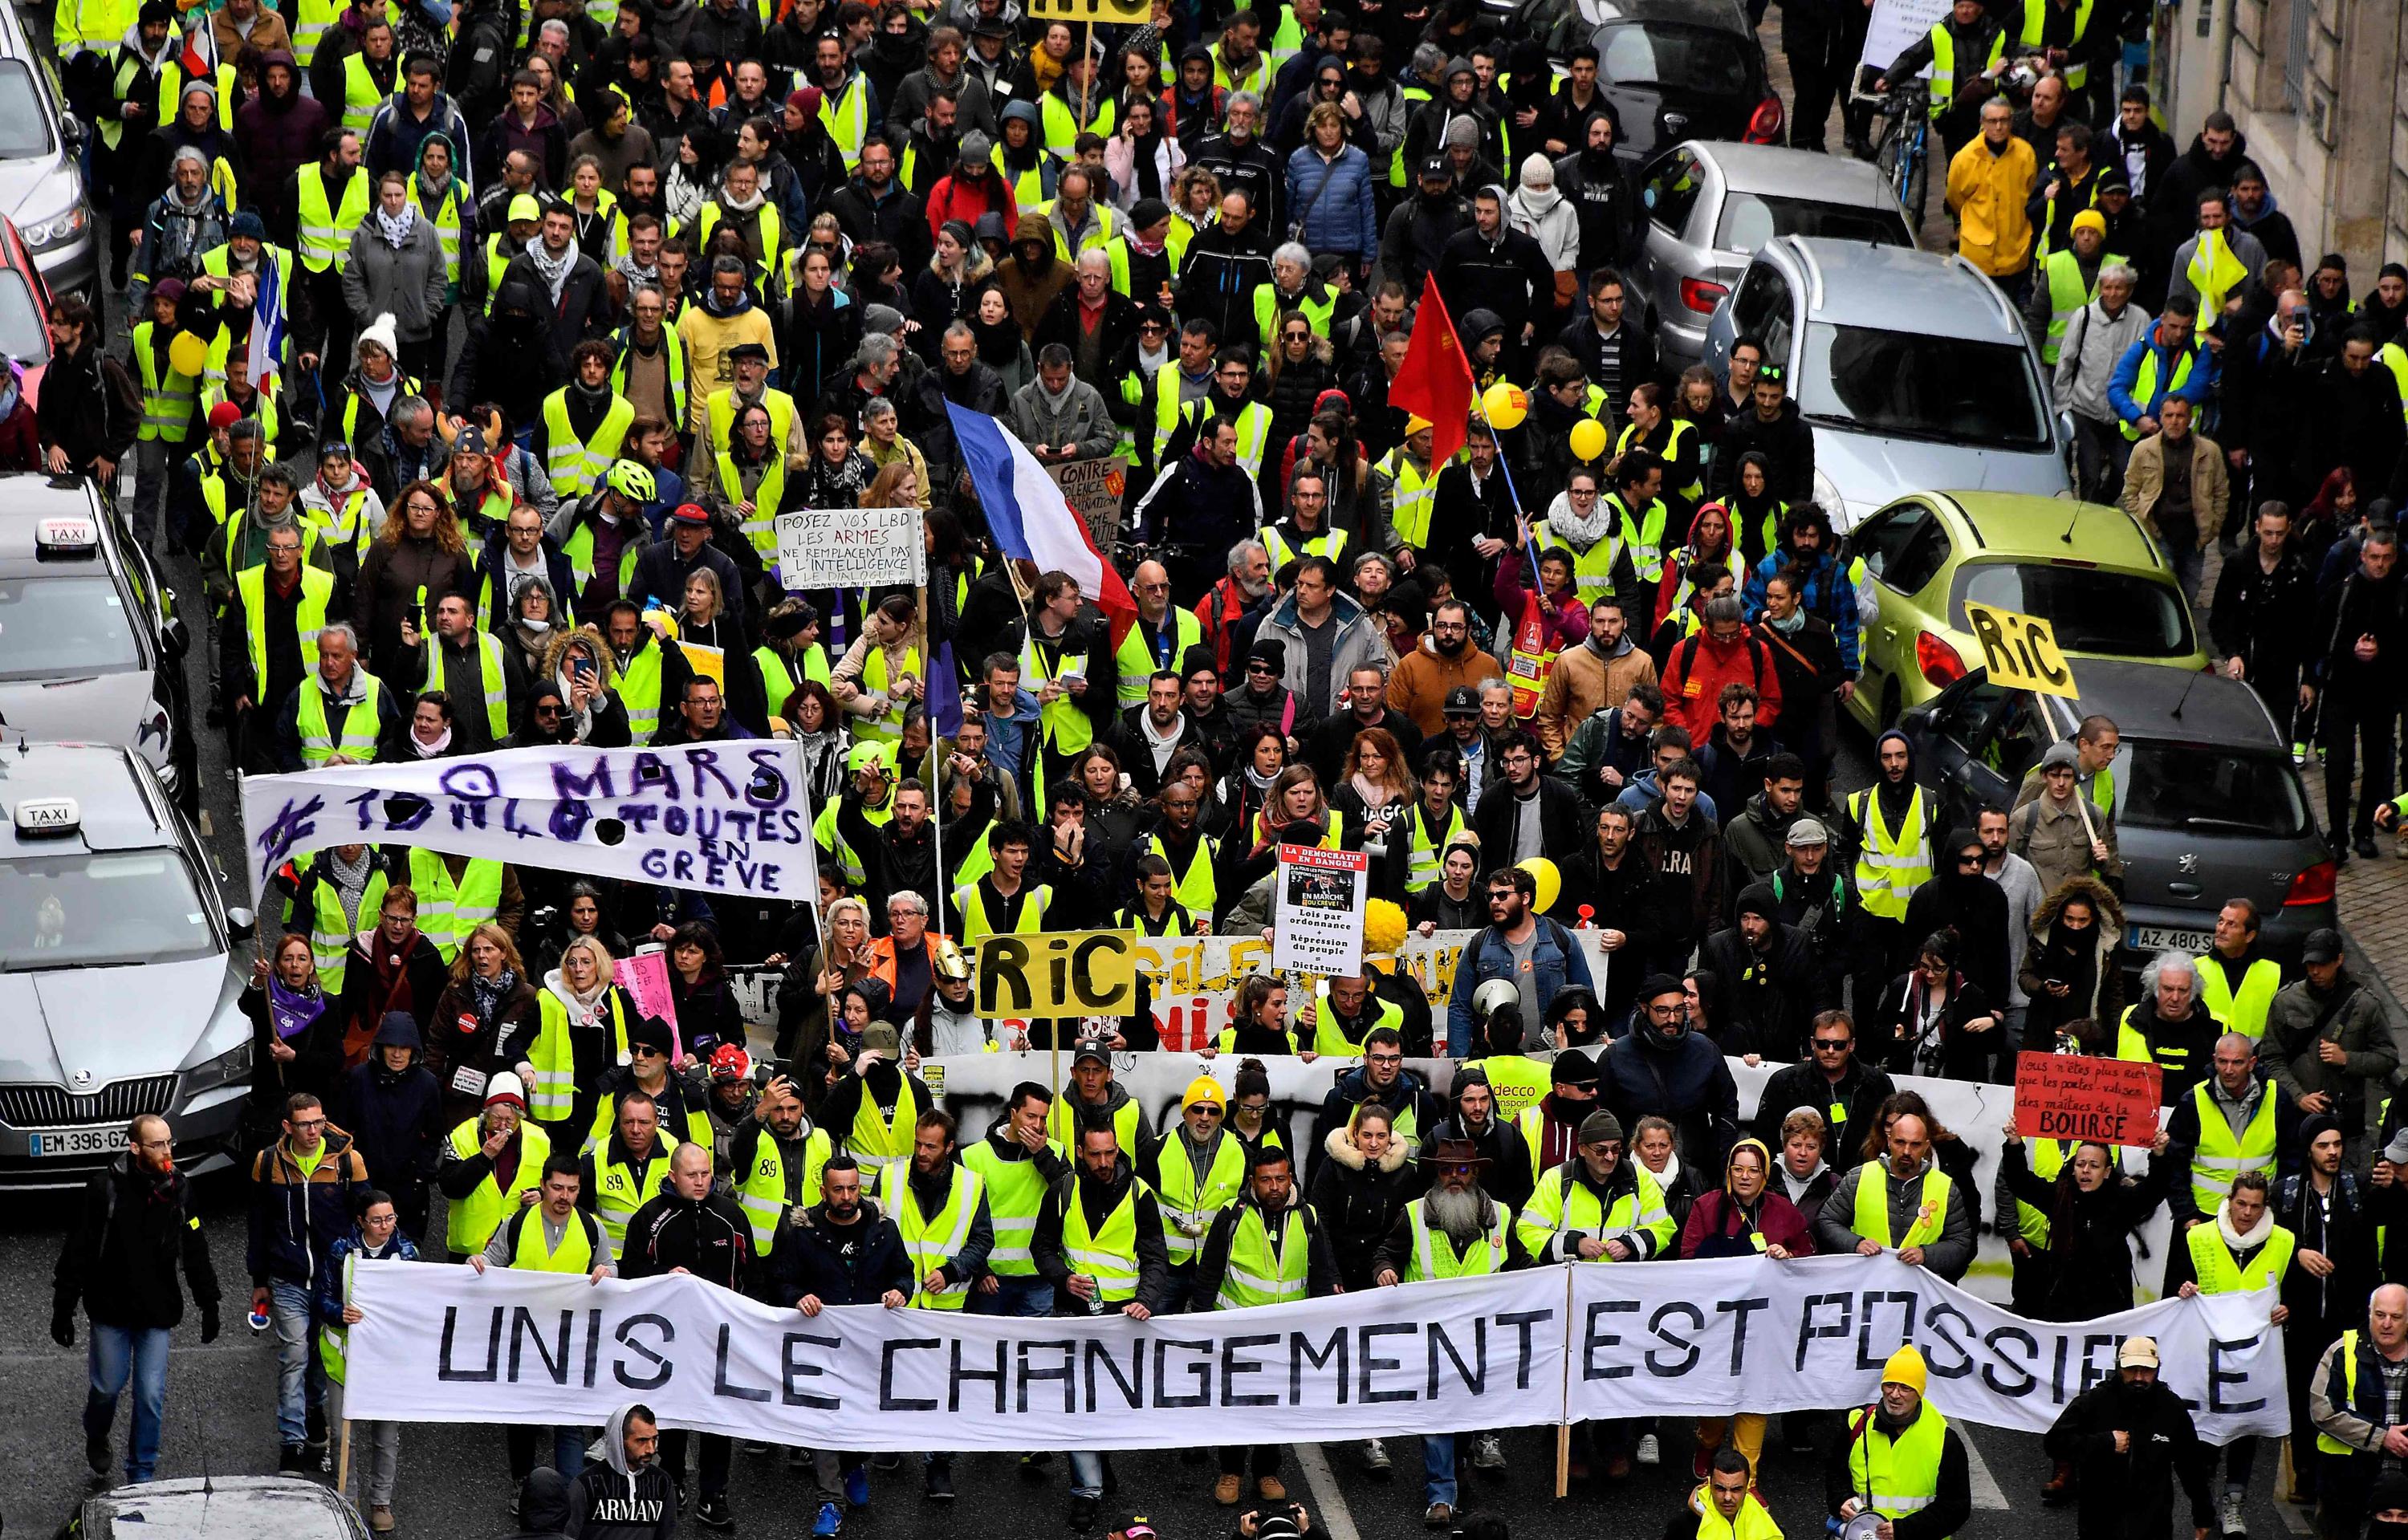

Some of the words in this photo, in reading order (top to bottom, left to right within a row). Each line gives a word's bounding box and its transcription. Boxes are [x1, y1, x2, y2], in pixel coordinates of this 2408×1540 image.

[1060, 461, 1111, 485] CONTRE
[783, 514, 832, 530] POSEZ
[840, 512, 870, 527] VOS
[880, 513, 909, 527] LBD
[50, 529, 86, 539] TAXI
[798, 531, 824, 546] LES
[834, 529, 889, 545] ARMES
[783, 548, 799, 558] NE
[806, 547, 886, 559] REMPLACENT
[891, 546, 910, 558] PAS
[795, 558, 908, 571] L'INTELLIGENCE
[783, 575, 797, 585] ET
[803, 571, 823, 582] LE
[828, 571, 894, 582] DIALOGUE
[550, 748, 790, 809] MARS
[29, 809, 67, 821] TAXI
[617, 804, 802, 844] TOUTES
[698, 839, 750, 861] EN
[1285, 847, 1297, 855] LA
[1302, 849, 1362, 862] DEMOCRATIE
[641, 848, 782, 892] GREVE
[1298, 855, 1311, 863] EN
[1316, 859, 1355, 869] DANGER
[1313, 893, 1345, 901] MARCHE
[1300, 909, 1320, 919] Lois
[1290, 918, 1352, 930] ordonnance
[1290, 933, 1348, 947] Répression
[2141, 930, 2215, 951] AZ-480-S
[1309, 945, 1344, 955] peuple
[1291, 961, 1343, 973] Dictature
[2017, 1054, 2047, 1071] Vous
[2095, 1065, 2119, 1084] plus
[2019, 1076, 2038, 1093] que
[2043, 1075, 2058, 1087] les
[2017, 1095, 2039, 1108] des
[2045, 1095, 2091, 1111] maîtres
[2095, 1102, 2110, 1113] de
[2116, 1102, 2129, 1115] la
[2039, 1111, 2128, 1140] BOURSE
[43, 1131, 130, 1152] EM-396-GZ
[759, 1159, 776, 1177] 89
[606, 1174, 624, 1191] 89
[438, 1306, 674, 1390] UNIS
[714, 1323, 841, 1410] LE
[880, 1309, 1552, 1413] CHANGEMENT
[1583, 1297, 1768, 1382] EST
